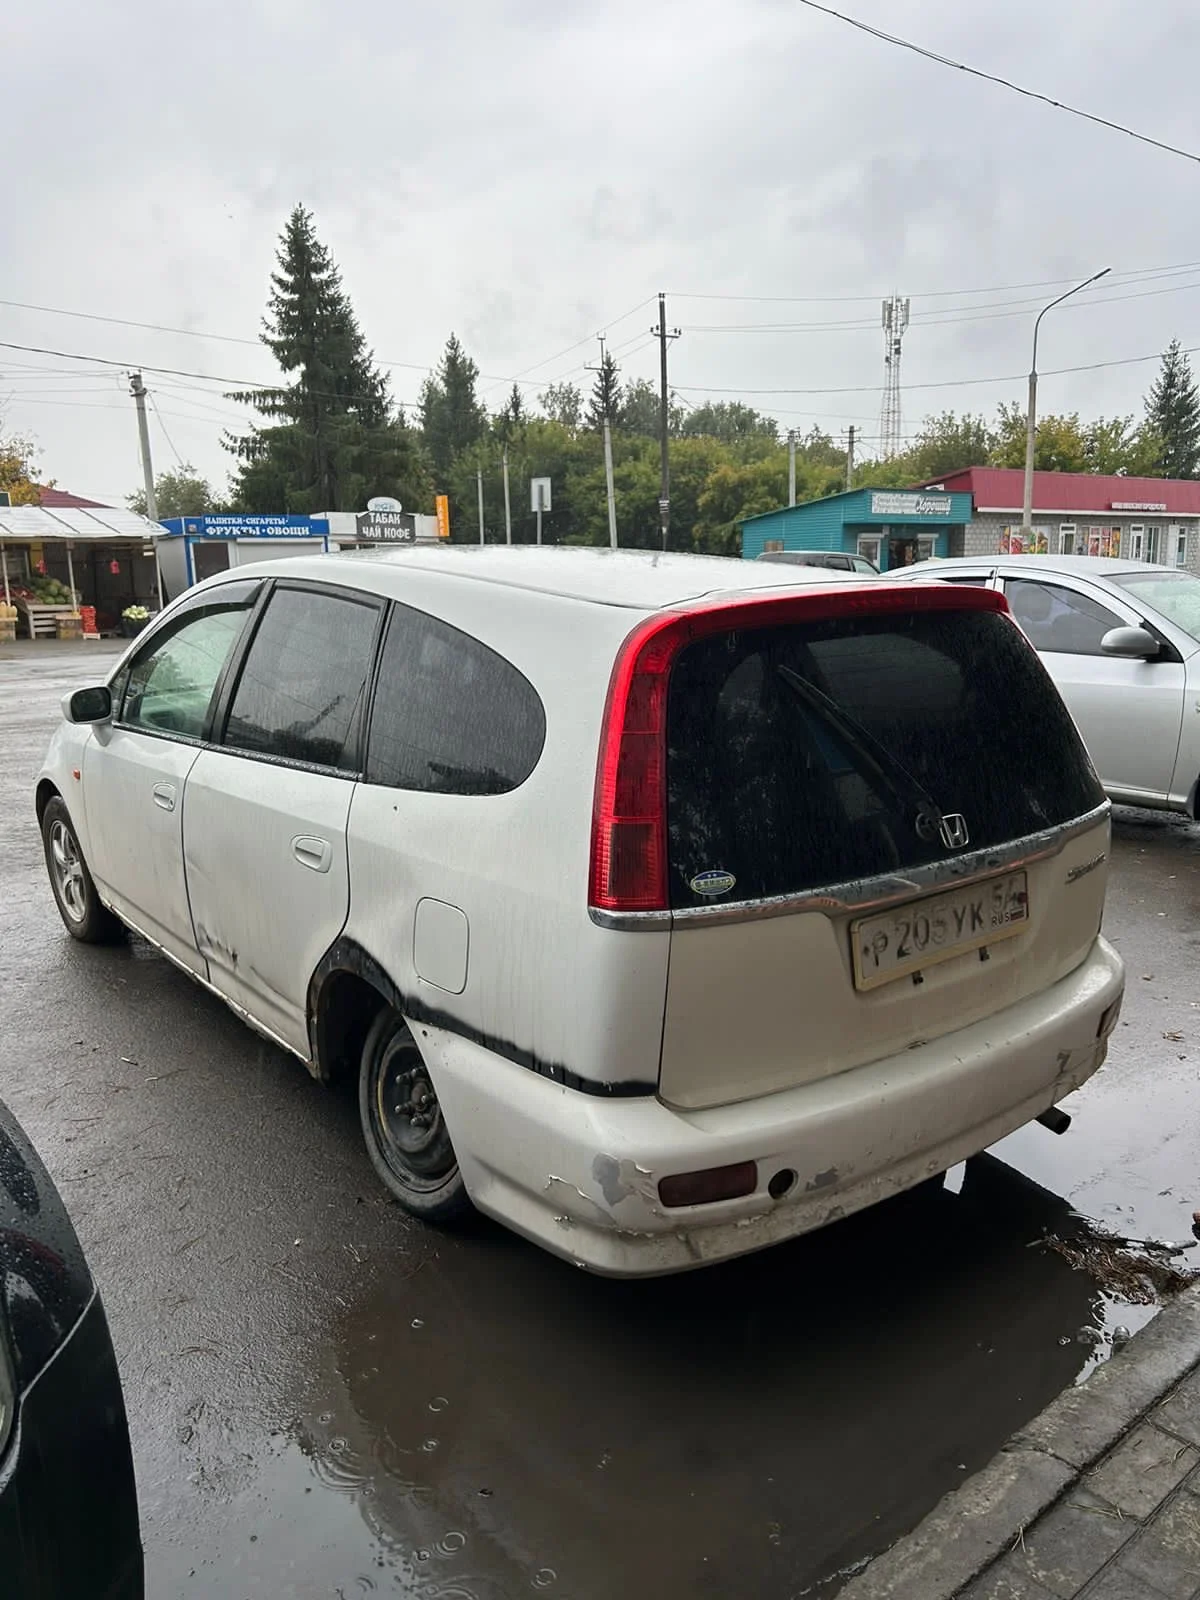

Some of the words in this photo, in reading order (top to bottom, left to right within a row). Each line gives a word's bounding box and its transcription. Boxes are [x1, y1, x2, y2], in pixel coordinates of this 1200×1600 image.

[368, 513, 401, 524] ТАБАК
[206, 526, 260, 536] ФРУКТЫ
[266, 526, 310, 536] ОВОЩИ
[362, 525, 382, 538] ЧАЙ
[384, 527, 411, 539] КОФЕ
[991, 911, 1011, 926] RUS
